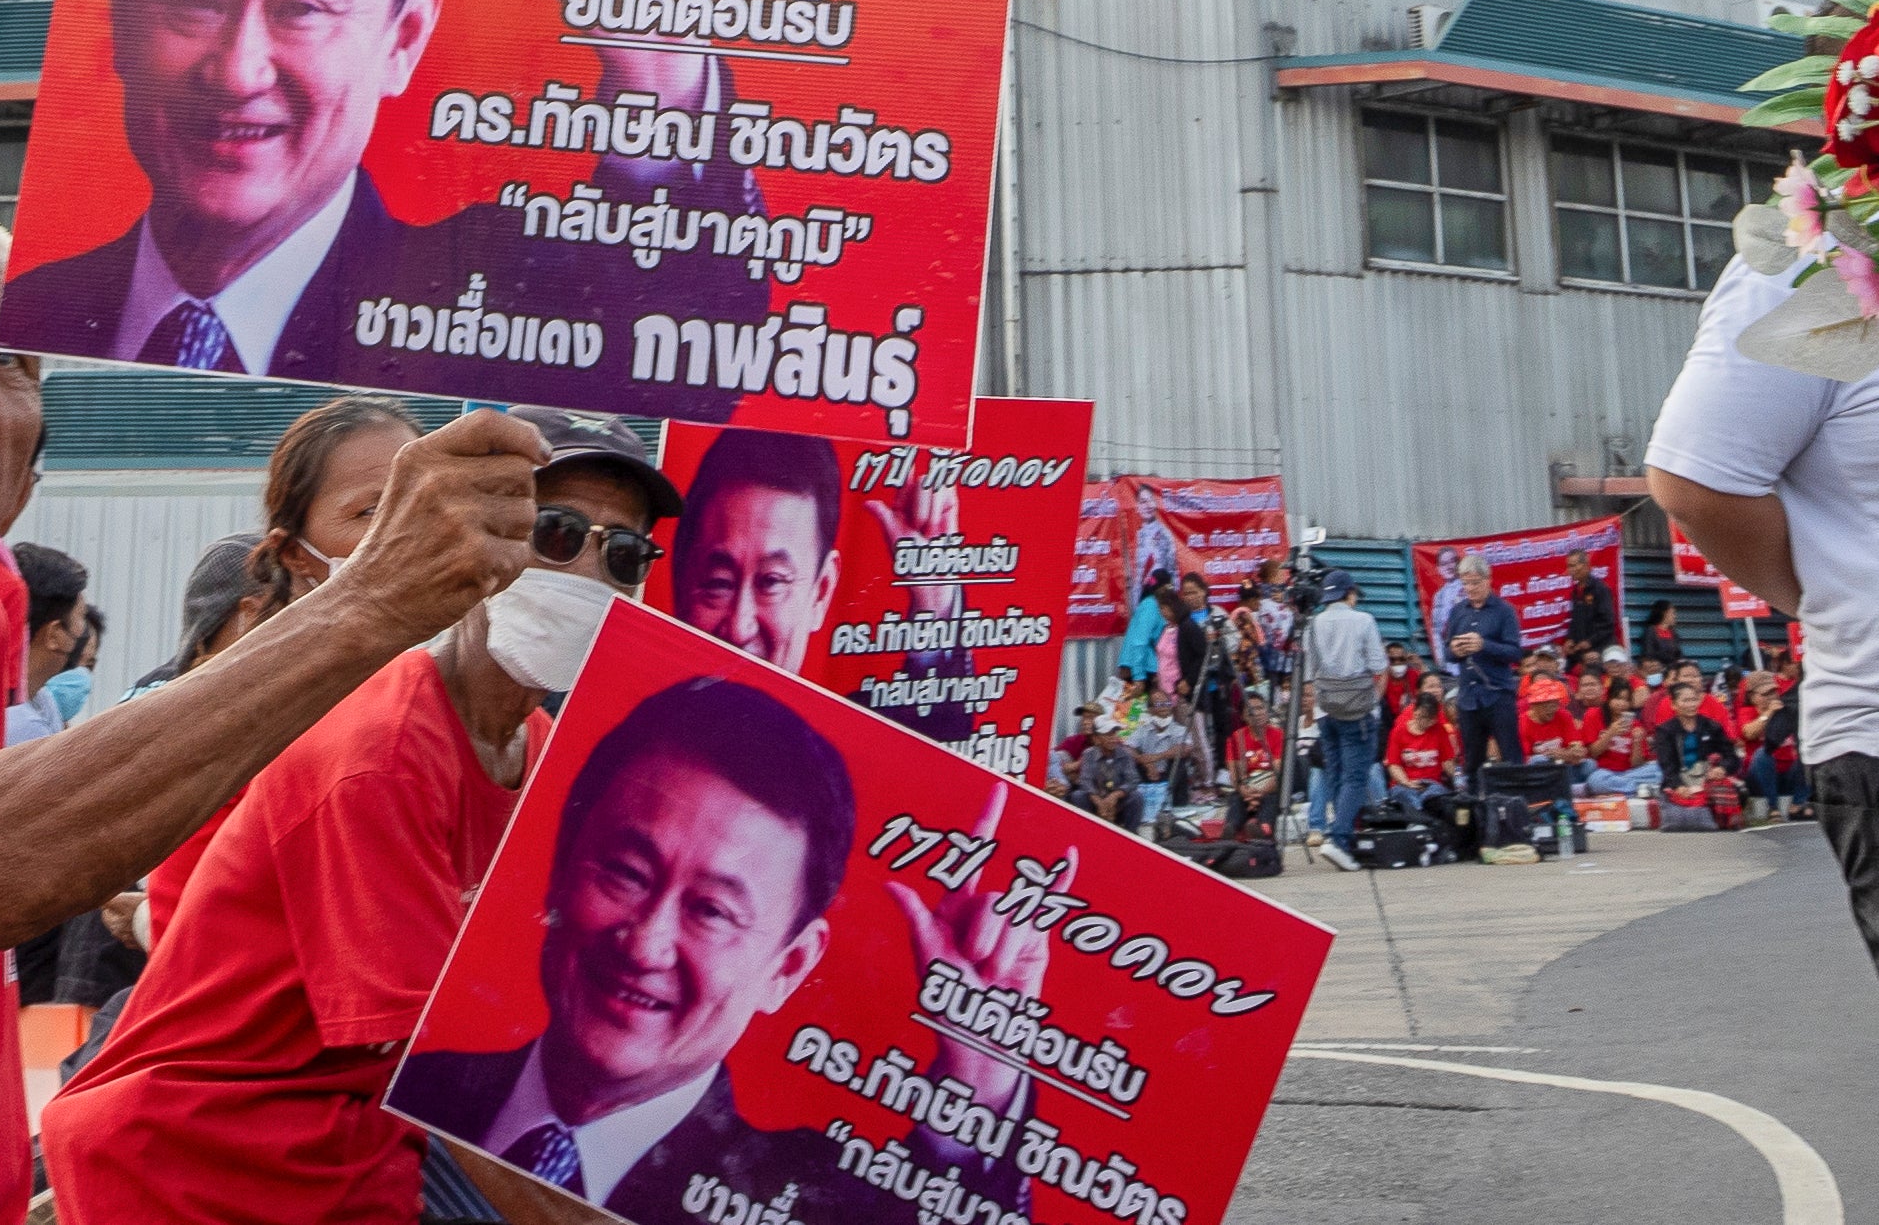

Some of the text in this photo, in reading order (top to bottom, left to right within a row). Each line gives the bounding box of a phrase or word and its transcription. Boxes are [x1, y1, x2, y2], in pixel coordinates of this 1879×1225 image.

[431, 83, 712, 160] ดร.ทักษิณ
[356, 274, 924, 435] ชาวเสื้อแดง กาฬสินธุ์
[894, 535, 1018, 575] ยินดีต้อนรับ
[868, 815, 1275, 1016] 17ปี ที่รอคอย
[787, 1025, 1015, 1158] ดร.ทักษิณ
[919, 962, 1147, 1106] ยินดีต้อนรับ
